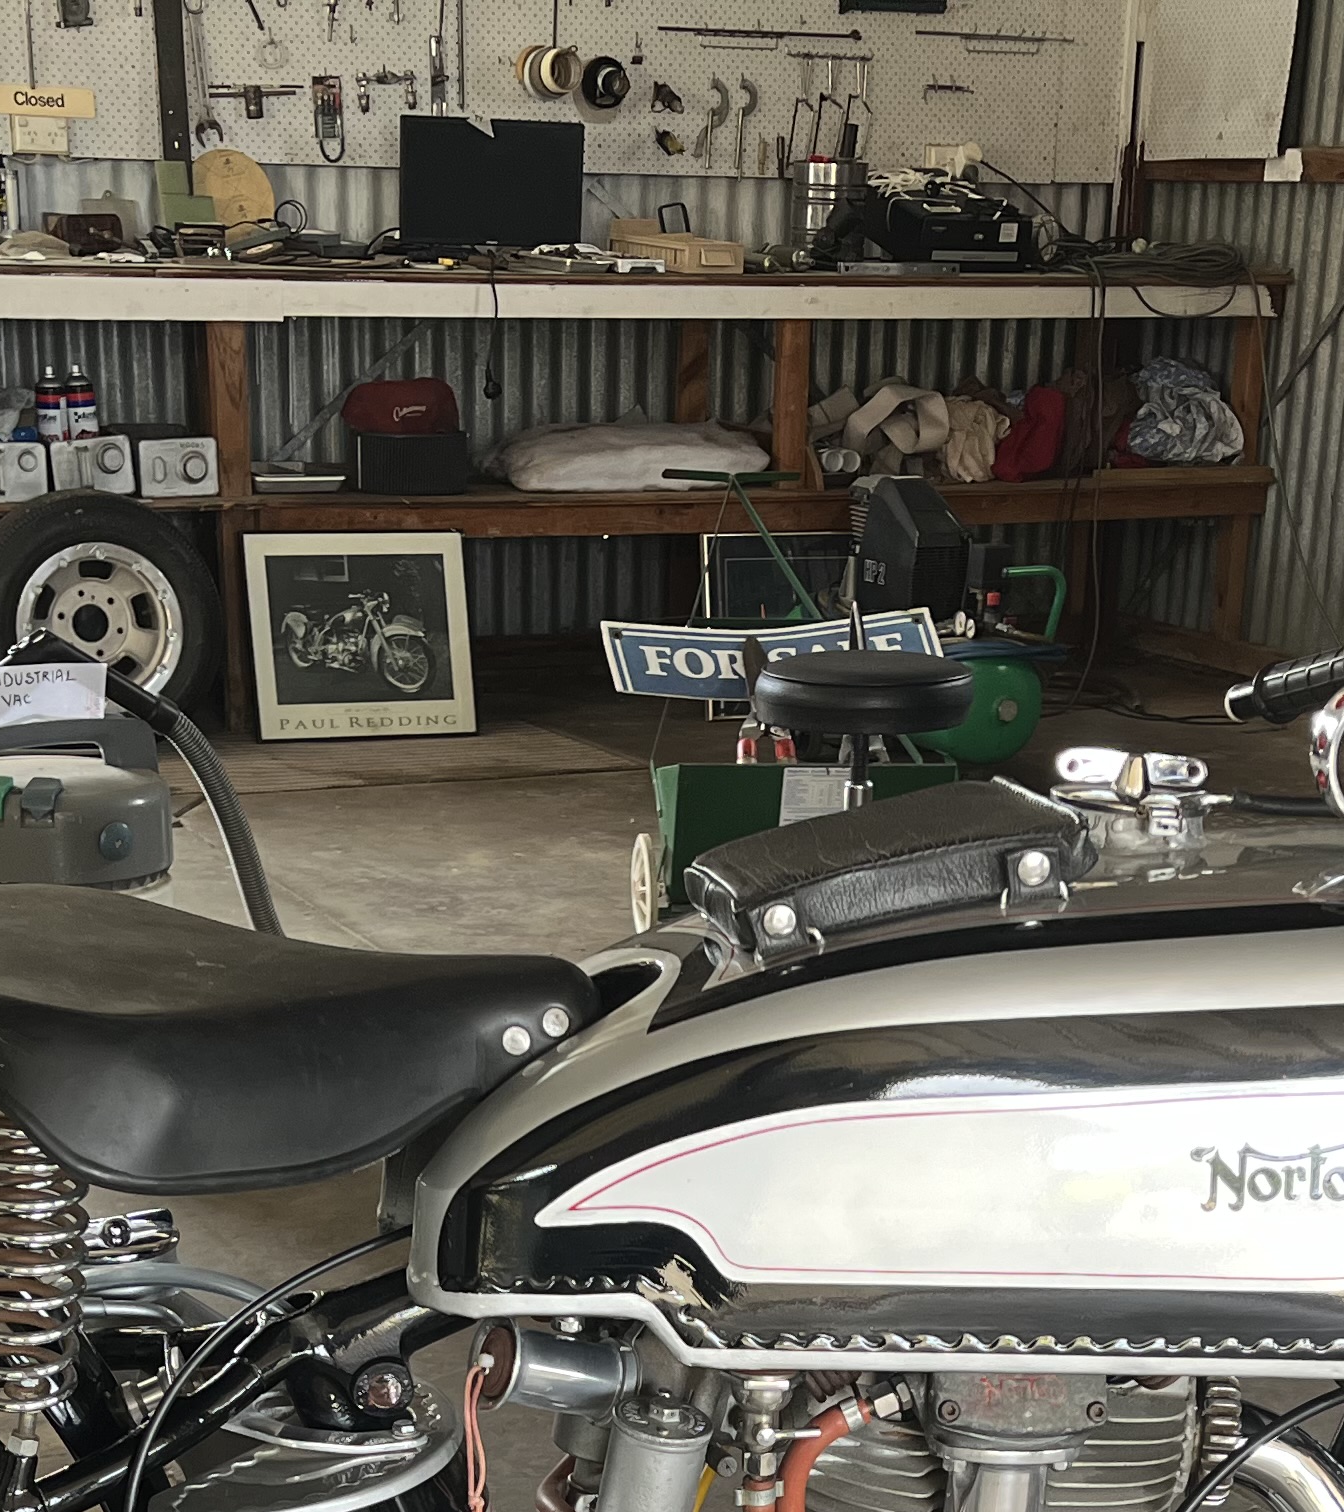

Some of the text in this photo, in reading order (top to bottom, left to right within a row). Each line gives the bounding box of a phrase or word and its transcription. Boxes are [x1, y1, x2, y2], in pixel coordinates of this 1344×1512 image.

[13, 91, 65, 108] Closed
[639, 644, 747, 681] FOR
[1, 694, 33, 708] VAC
[279, 714, 458, 731] PAUL REDDING
